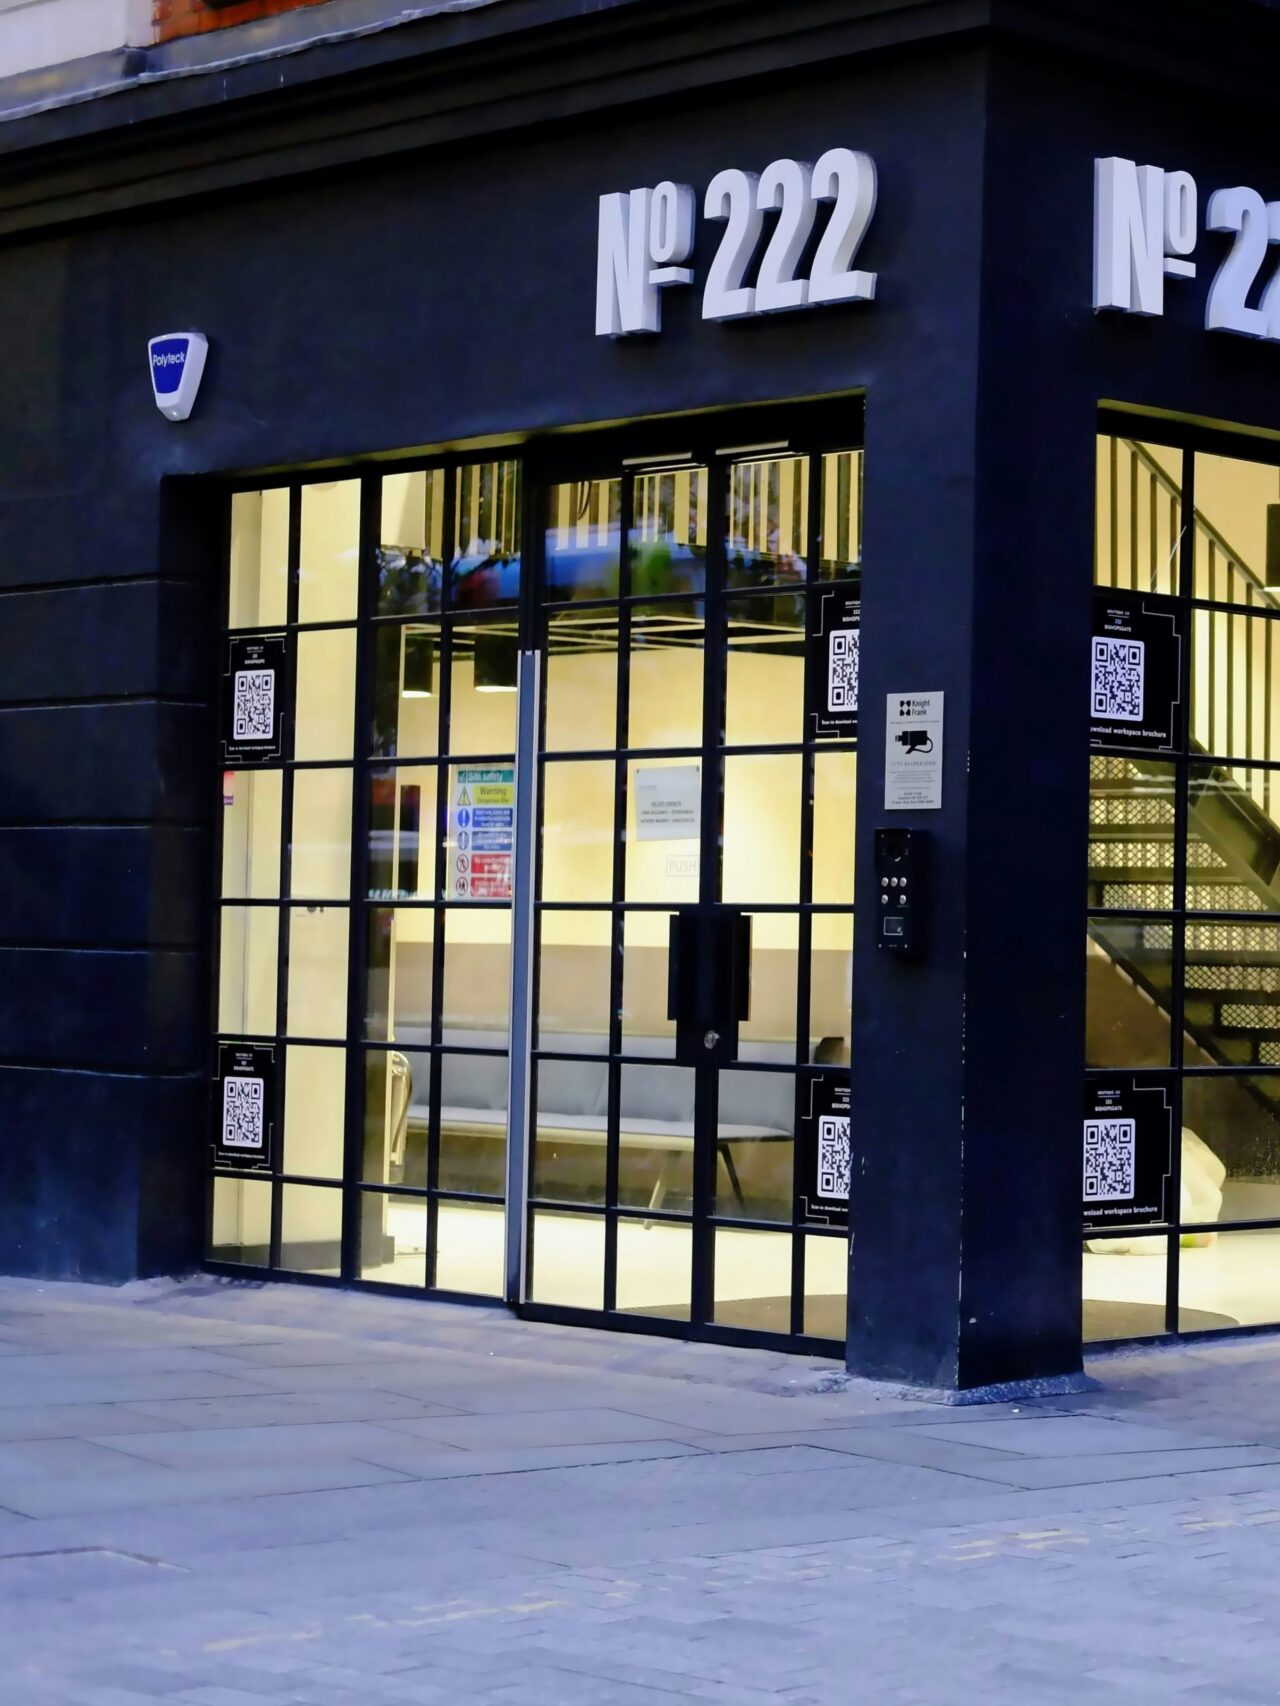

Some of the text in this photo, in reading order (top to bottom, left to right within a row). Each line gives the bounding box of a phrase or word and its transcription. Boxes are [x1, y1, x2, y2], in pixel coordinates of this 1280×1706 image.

[702, 147, 878, 323] 222
[152, 351, 186, 368] Polyteck
[911, 699, 931, 709] Knight
[911, 708, 927, 716] Frank
[1113, 727, 1142, 737] workspace
[1142, 729, 1167, 739] brochure
[482, 770, 504, 782] safety
[480, 786, 507, 796] Warning
[669, 859, 697, 873] PUSH
[1083, 1205, 1158, 1216] wnload workspace brochure
